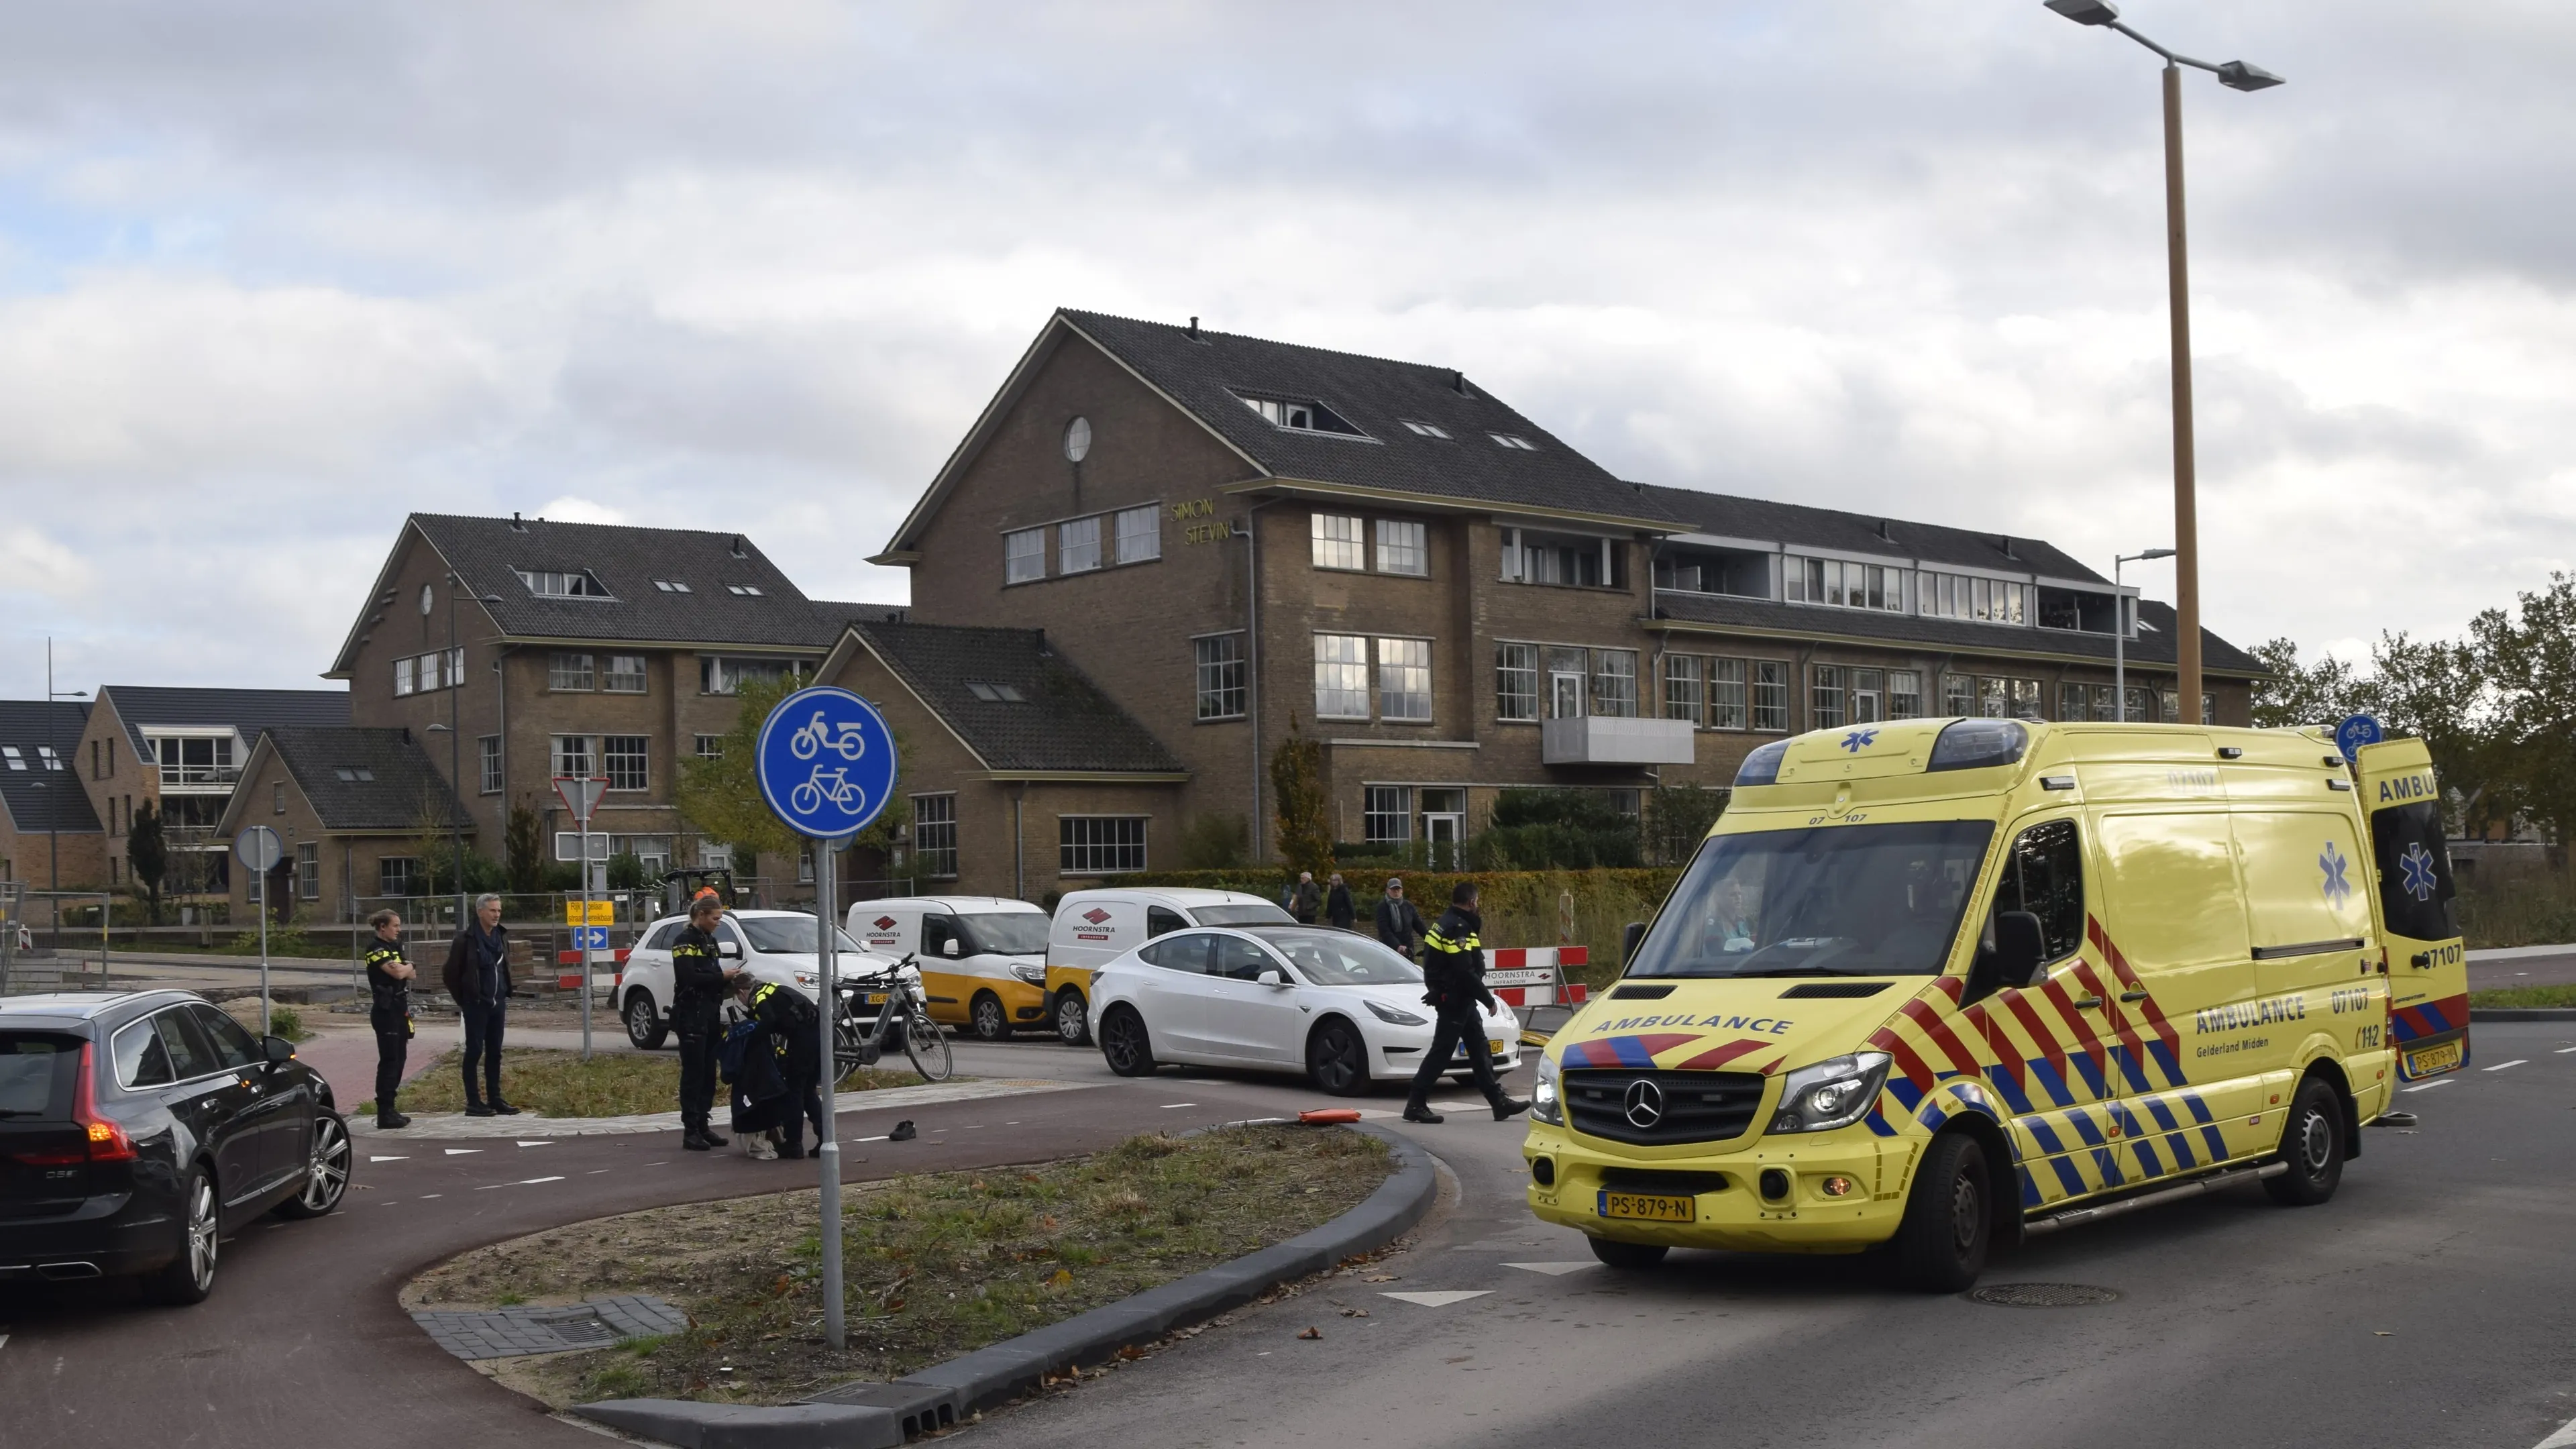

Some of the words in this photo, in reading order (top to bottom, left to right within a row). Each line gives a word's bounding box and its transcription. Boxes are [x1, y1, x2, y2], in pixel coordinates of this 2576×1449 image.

[1171, 498, 1213, 521] SIMON
[1185, 523, 1229, 545] STEVIN
[2380, 774, 2434, 802] AMBU
[1809, 816, 1825, 825] 07
[1845, 814, 1868, 822] 107
[587, 913, 612, 922] ereikbaar
[1485, 971, 1535, 980] HOORNSTRA
[2332, 987, 2369, 1014] 07107
[1590, 1014, 1794, 1034] AMBULANCE
[2196, 996, 2306, 1035] AMBULANCE
[2196, 1040, 2240, 1058] Gelderland
[2242, 1037, 2269, 1051] Midden
[1611, 1196, 1686, 1218] PS-879-N
